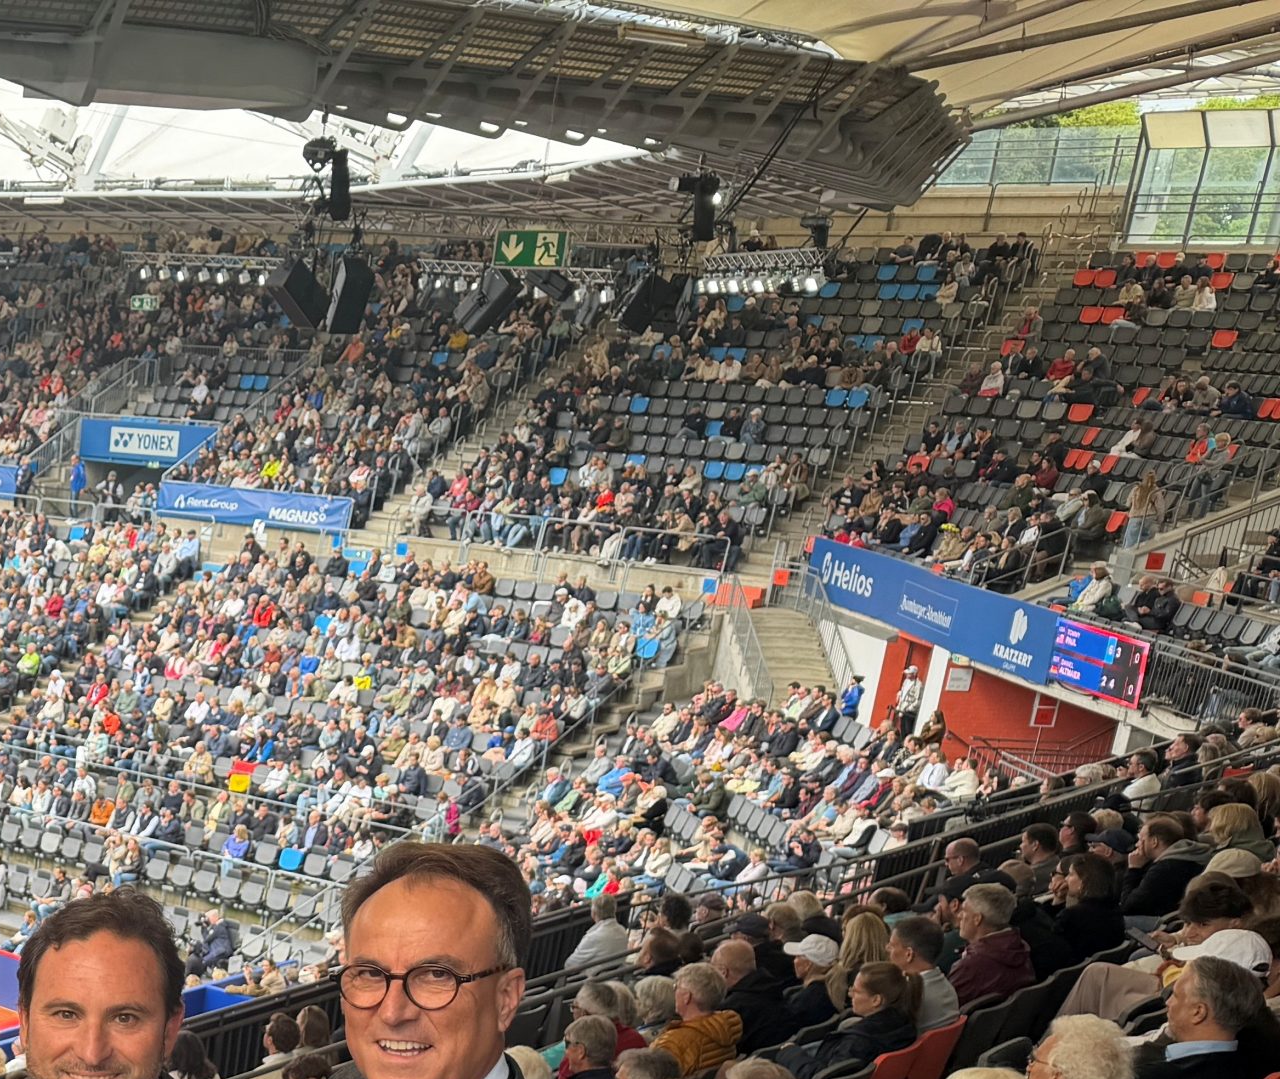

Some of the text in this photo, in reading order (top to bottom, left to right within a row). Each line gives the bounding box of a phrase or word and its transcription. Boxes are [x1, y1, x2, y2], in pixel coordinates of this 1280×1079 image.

[136, 432, 174, 451] YONEX
[268, 506, 321, 525] MAGNUS
[831, 560, 874, 598] Helios
[992, 642, 1033, 668] KRATZERT
[1116, 646, 1122, 658] 3
[1134, 652, 1141, 664] 0
[1100, 675, 1108, 687] 2
[1109, 678, 1115, 689] 4
[1128, 684, 1134, 695] 0
